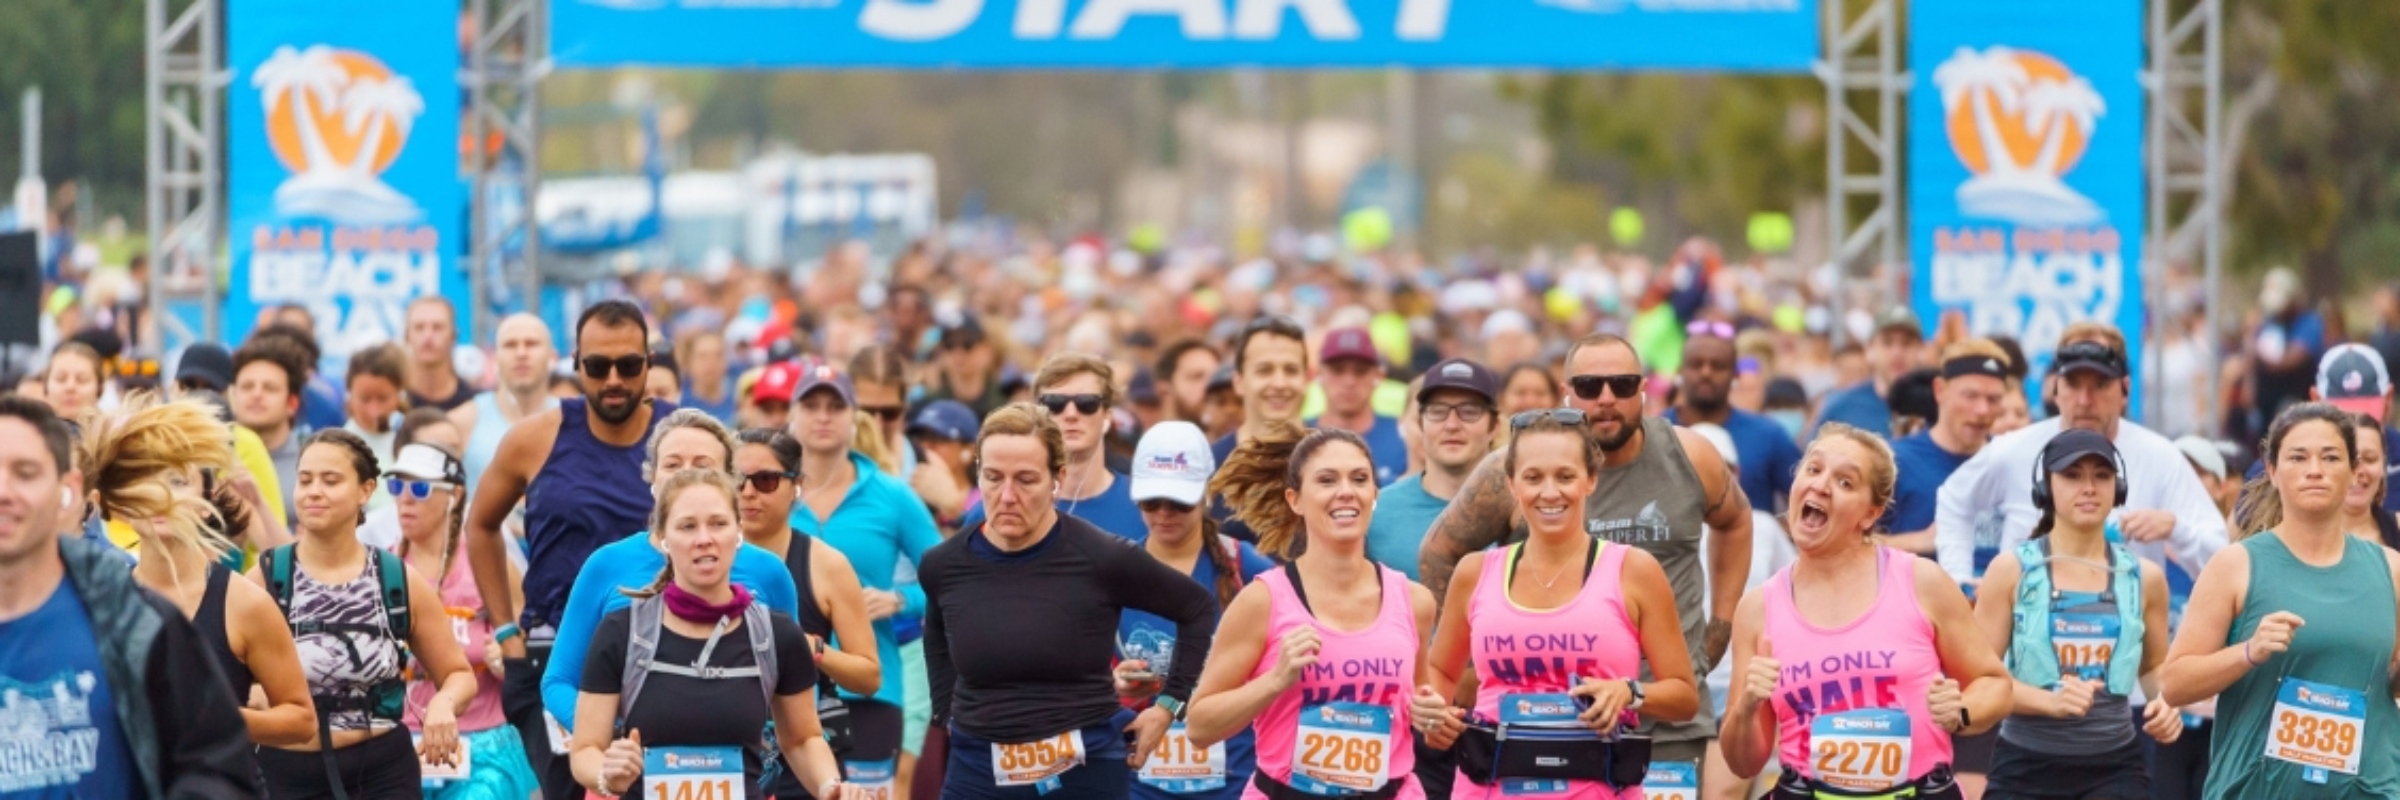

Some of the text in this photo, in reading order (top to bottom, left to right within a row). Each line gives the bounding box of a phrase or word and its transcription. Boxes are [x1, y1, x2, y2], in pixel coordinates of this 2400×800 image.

[250, 252, 440, 302] BEACH
[1932, 253, 2123, 303] BEACH
[1589, 518, 1633, 532] Team
[1483, 633, 1598, 653] I'M ONLY
[1300, 657, 1403, 682] I'M ONLY
[1780, 650, 1896, 688] I'M ONLY
[998, 730, 1076, 771] 3554
[2276, 710, 2357, 756] 3339
[1301, 733, 1384, 774] 2268
[1817, 740, 1904, 777] 2270
[654, 779, 731, 800] 1441
